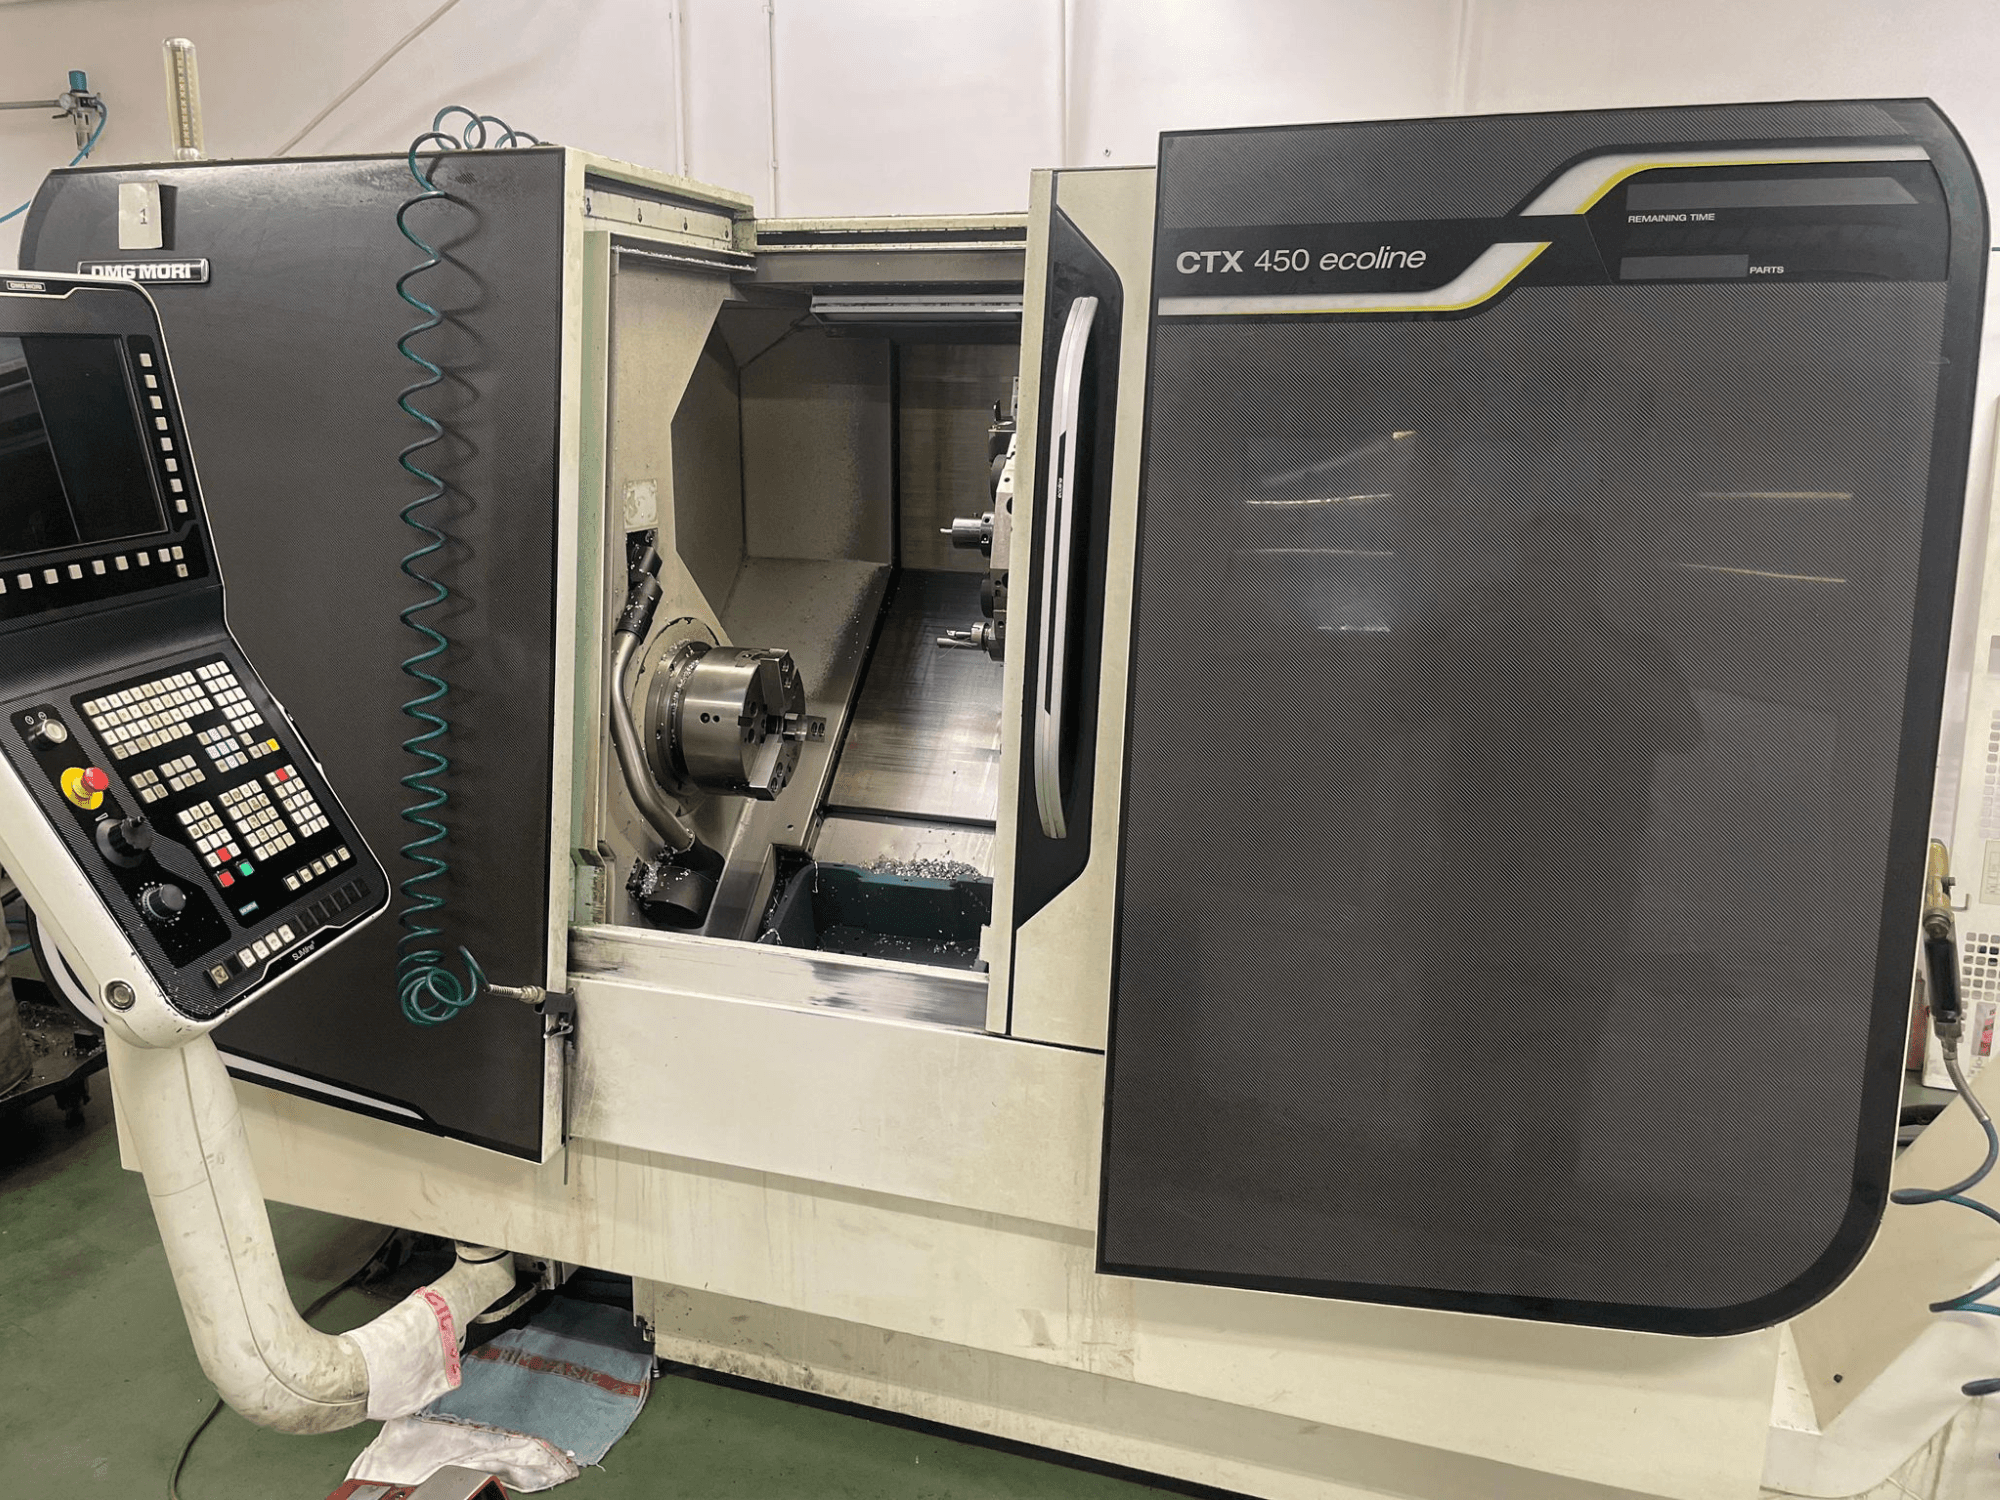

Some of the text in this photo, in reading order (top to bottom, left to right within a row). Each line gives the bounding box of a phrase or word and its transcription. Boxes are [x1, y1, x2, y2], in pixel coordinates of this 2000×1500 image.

[1628, 213, 1715, 223] REMAINING TIME
[1176, 246, 1427, 274] CTX 450 ecoline
[138, 263, 191, 280] MORI
[1749, 266, 1784, 274] PARTS
